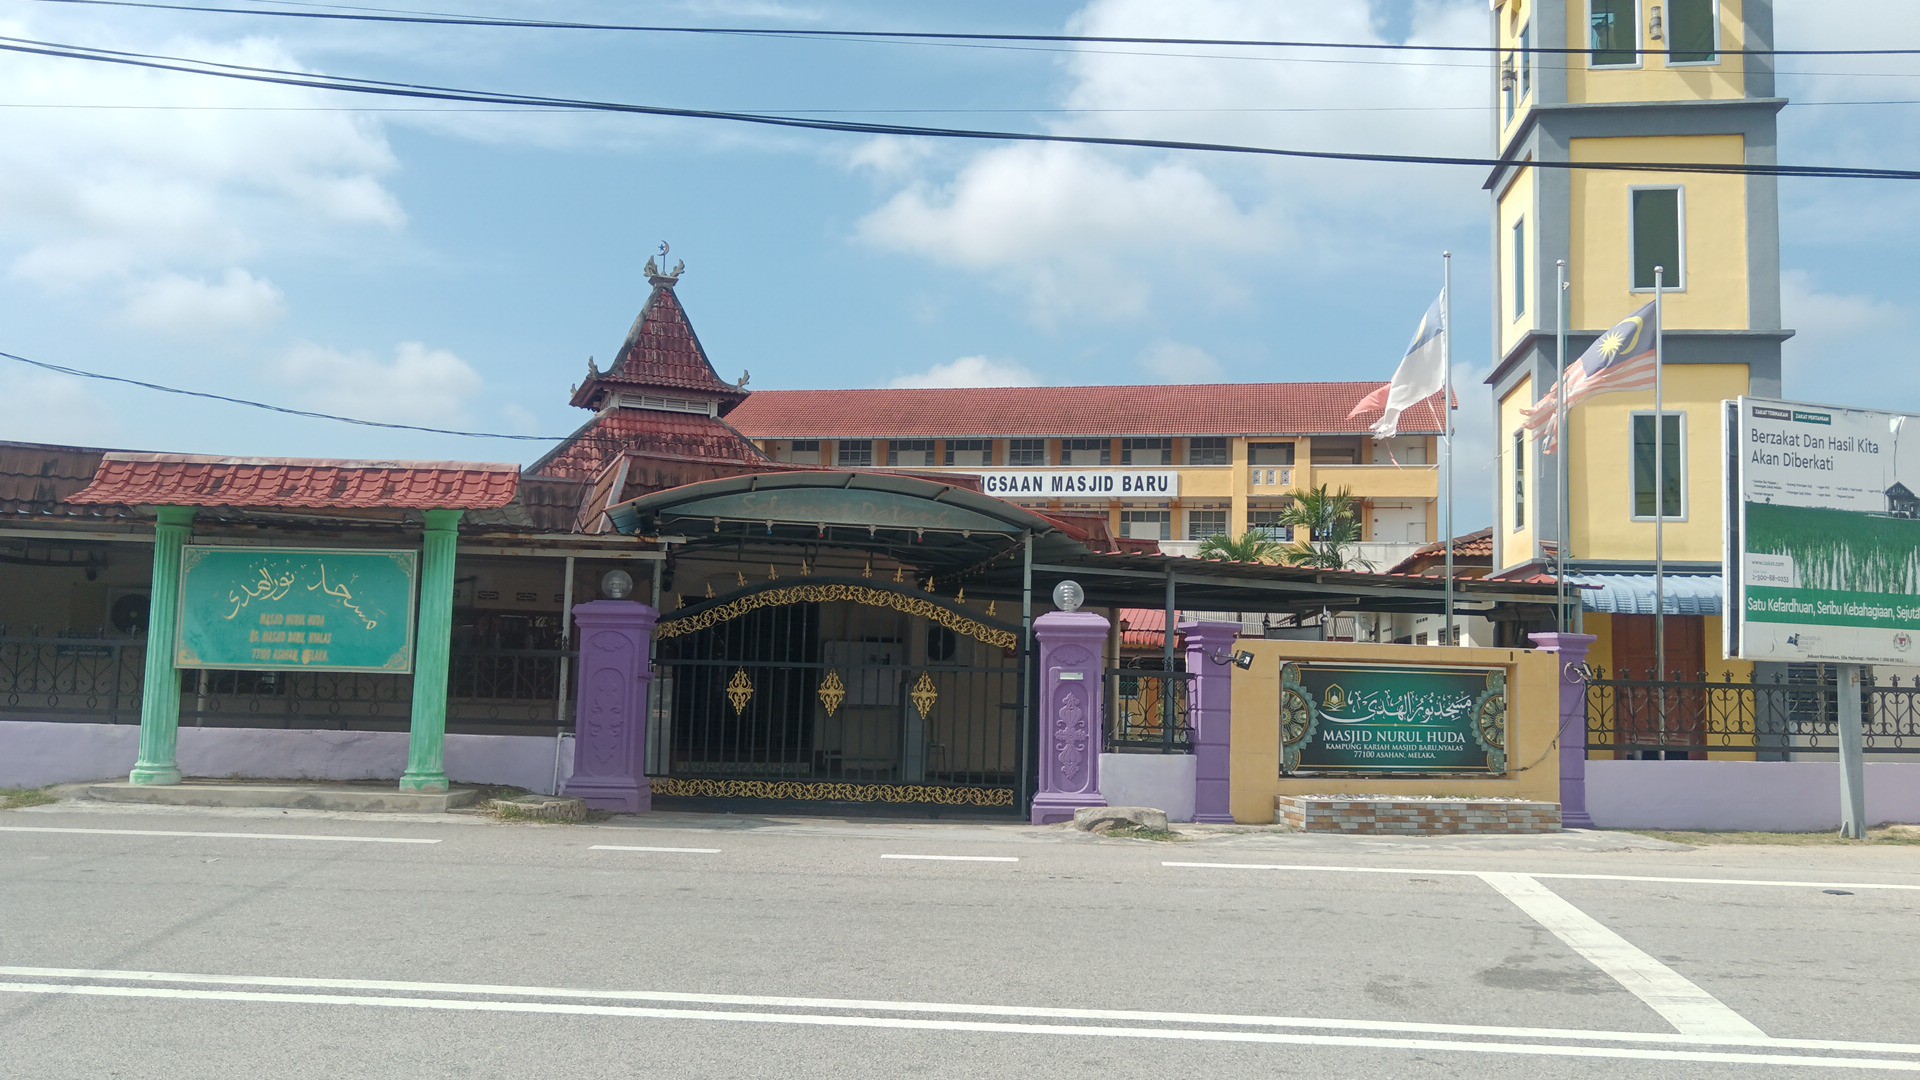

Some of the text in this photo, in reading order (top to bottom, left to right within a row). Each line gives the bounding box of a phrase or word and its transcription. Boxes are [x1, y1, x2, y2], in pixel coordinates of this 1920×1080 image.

[1751, 428, 1879, 454] Berzakat Dan Hasil Kita
[1751, 449, 1834, 471] Akan Diberkati
[1051, 476, 1114, 492] MASJID
[1122, 476, 1168, 492] BARU
[1747, 597, 1767, 612] Satu
[1767, 597, 1816, 617] Kefardhuan,
[1817, 601, 1843, 616] Seribu
[1843, 603, 1895, 620] Kebahagiaan,
[1322, 730, 1466, 744] MASJID NURUL HUDA
[1325, 743, 1362, 751] KAMPUNG
[1363, 743, 1390, 751] KARIAH
[1392, 744, 1417, 752] MASJID
[1353, 751, 1375, 759] 77100
